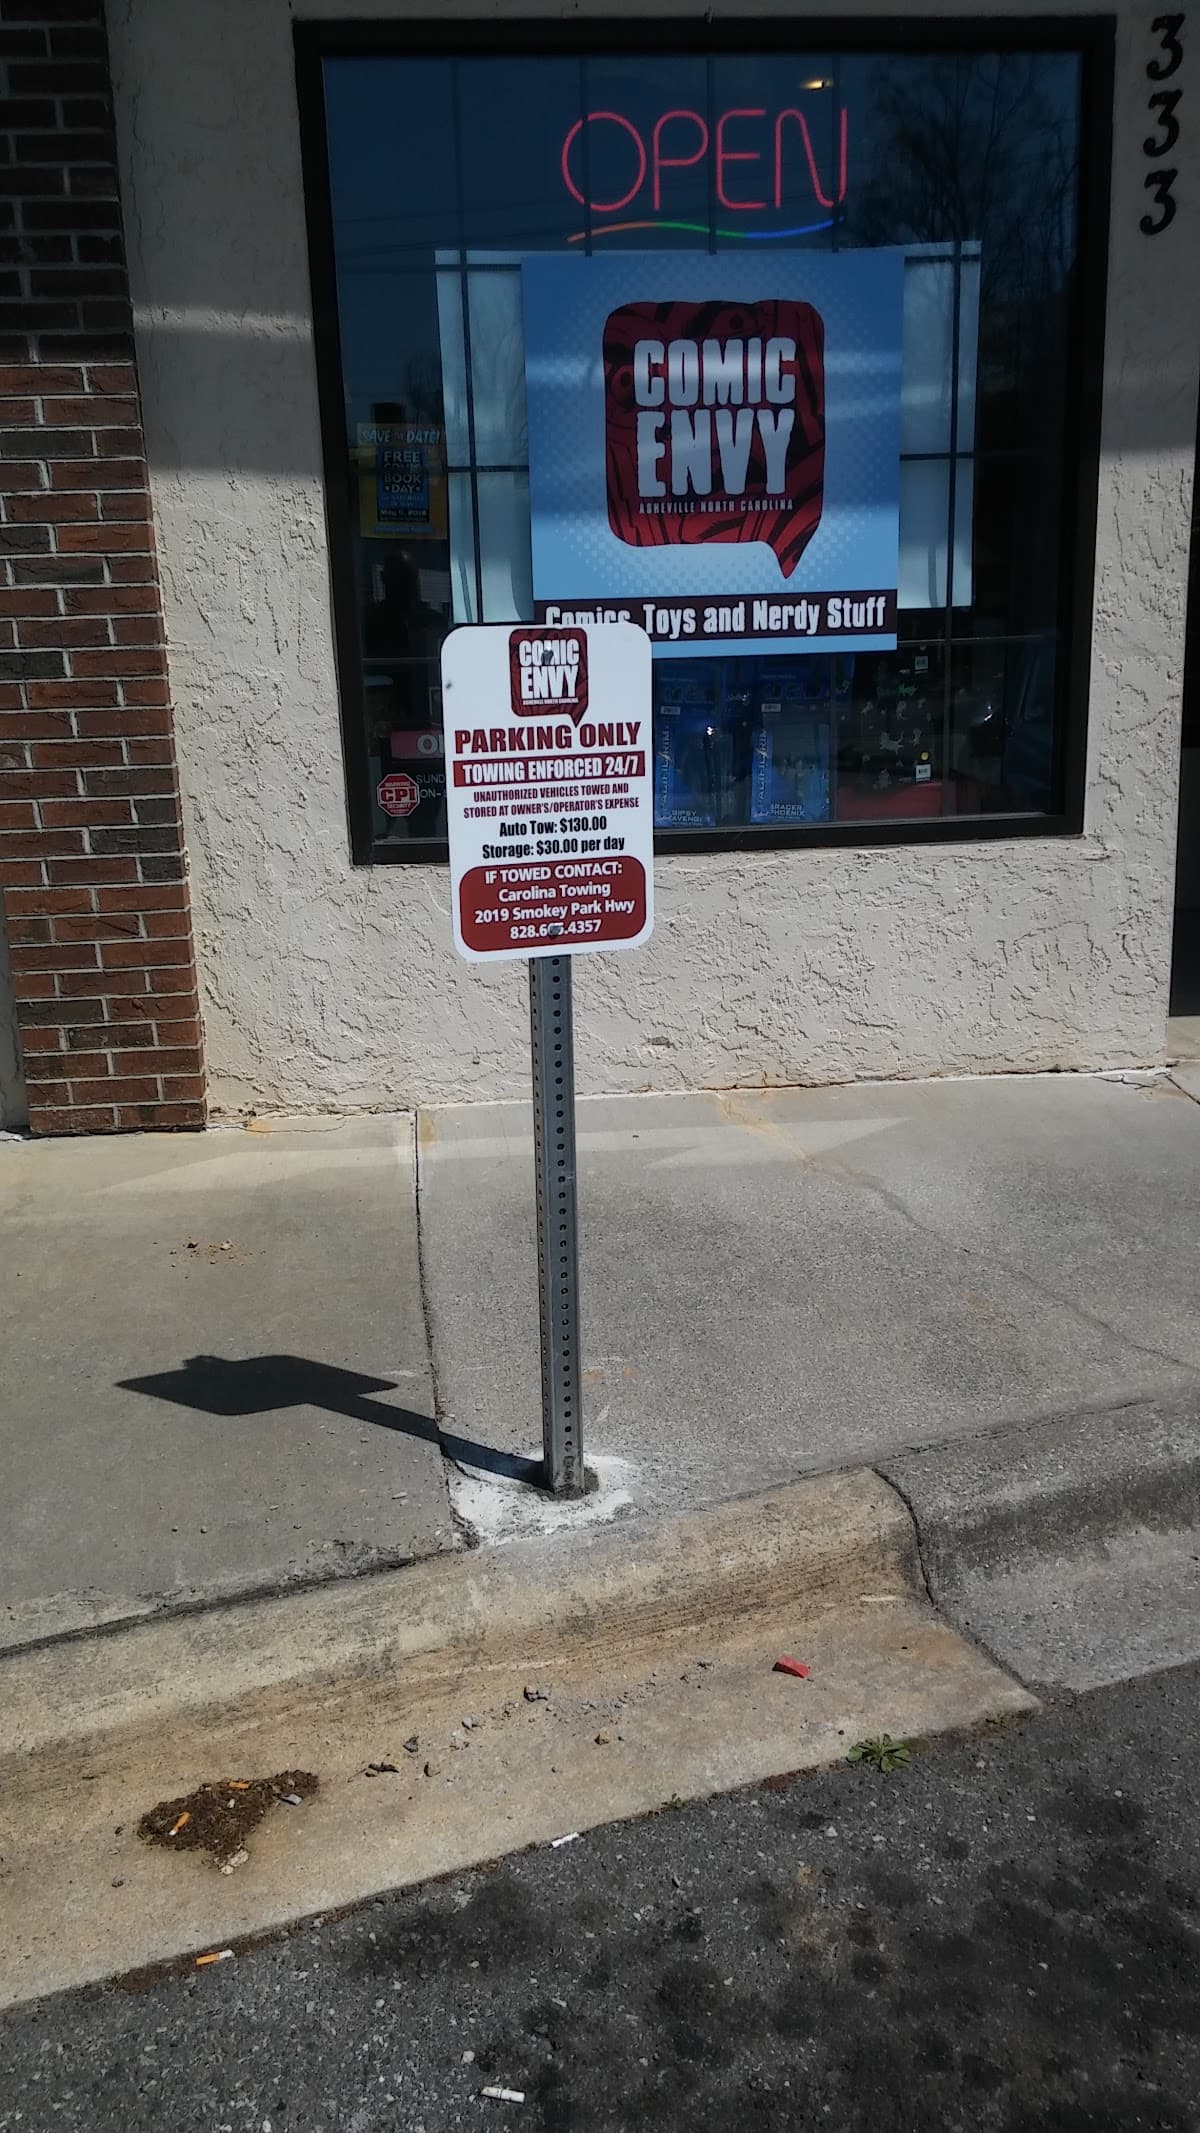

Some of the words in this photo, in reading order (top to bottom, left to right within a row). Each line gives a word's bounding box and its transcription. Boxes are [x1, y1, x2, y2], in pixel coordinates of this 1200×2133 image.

[561, 108, 847, 212] OPEN
[634, 337, 796, 407] COMIC
[384, 451, 420, 462] FREE
[637, 408, 795, 497] ENVY
[384, 474, 421, 483] BOOK
[392, 485, 414, 493] DAY
[639, 502, 695, 514] ASHEVILLE
[700, 501, 735, 513] NORTH
[740, 499, 793, 512] CAROLINA
[643, 603, 697, 639] Toys
[703, 602, 745, 633] and
[752, 600, 820, 635] Nerdy
[827, 596, 886, 629] Stuff
[519, 639, 579, 667] COMIC
[521, 665, 578, 699] ENVY
[455, 724, 572, 754] PARKING
[580, 721, 642, 748] ONLY
[463, 761, 525, 784] TOWING
[528, 758, 601, 781] ENFORCED
[605, 755, 639, 776] 24/7
[380, 788, 417, 802] CPI
[473, 788, 538, 802] UNAUTHORIZED
[539, 785, 579, 799] VEHICLES
[581, 784, 610, 796] TOWED
[612, 783, 629, 794] AND
[464, 807, 497, 819] STORED
[499, 805, 509, 816] AT
[511, 799, 603, 816] OWNER'S/OPERATOR'S
[605, 797, 639, 809] EXPENSE
[500, 822, 527, 837] Auto
[529, 820, 558, 835] Tow:
[559, 816, 607, 833] $130.00
[482, 843, 534, 859] Storage:
[536, 838, 578, 856] $30.00
[581, 839, 601, 853] per
[603, 836, 625, 851] day
[485, 871, 498, 884] IF
[500, 867, 550, 883] TOWED
[554, 861, 623, 878] CONTACT:
[499, 885, 556, 902] Carolina
[559, 882, 611, 898] Towing
[475, 909, 509, 924] 2019
[512, 905, 568, 920] Smokey
[571, 902, 602, 916] Park
[605, 900, 635, 914] Hwy
